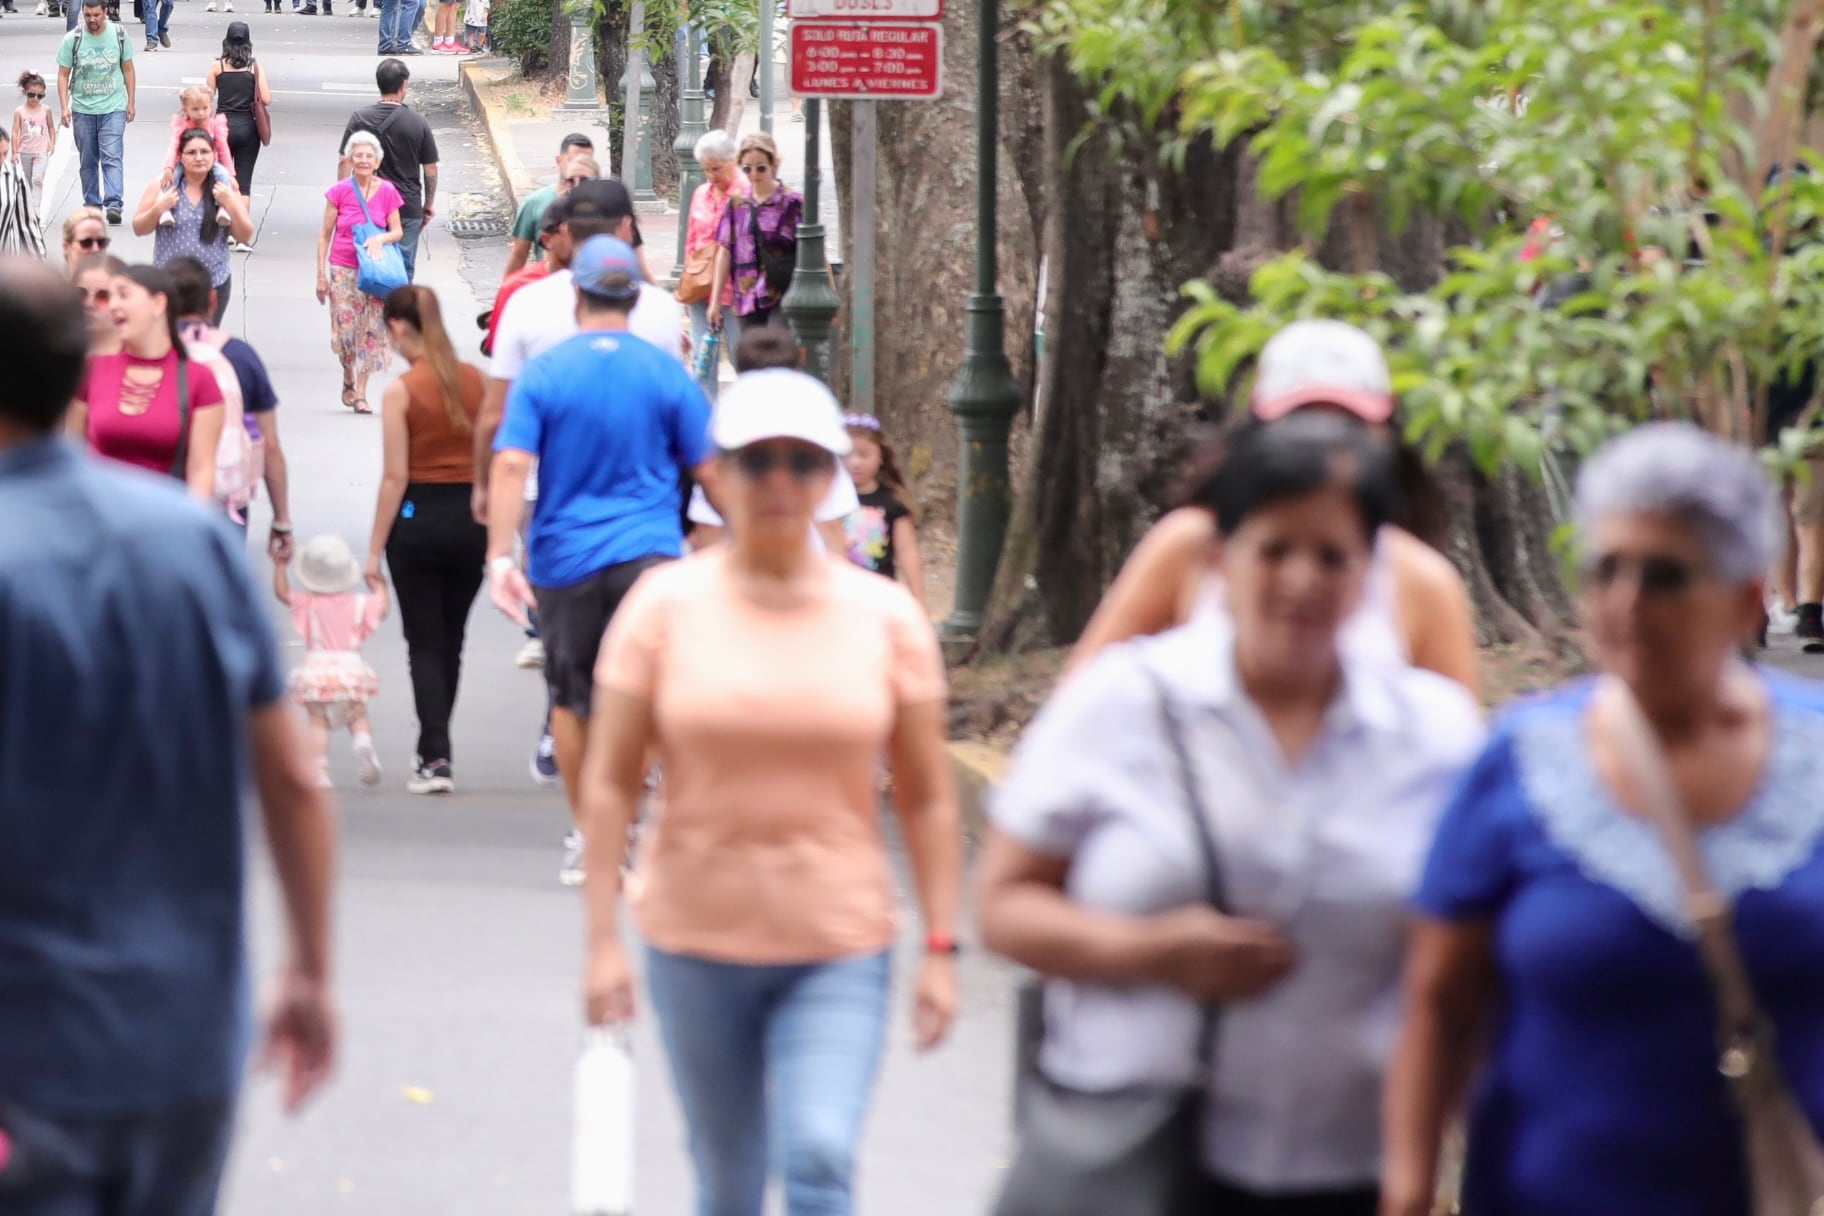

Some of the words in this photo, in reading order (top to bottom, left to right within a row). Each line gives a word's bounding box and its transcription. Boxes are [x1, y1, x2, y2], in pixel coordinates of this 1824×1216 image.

[801, 29, 835, 41] SOLO
[838, 29, 868, 42] RUTA
[870, 30, 929, 43] REGULAR
[803, 77, 849, 88] LUNES
[866, 78, 929, 90] VIERNES
